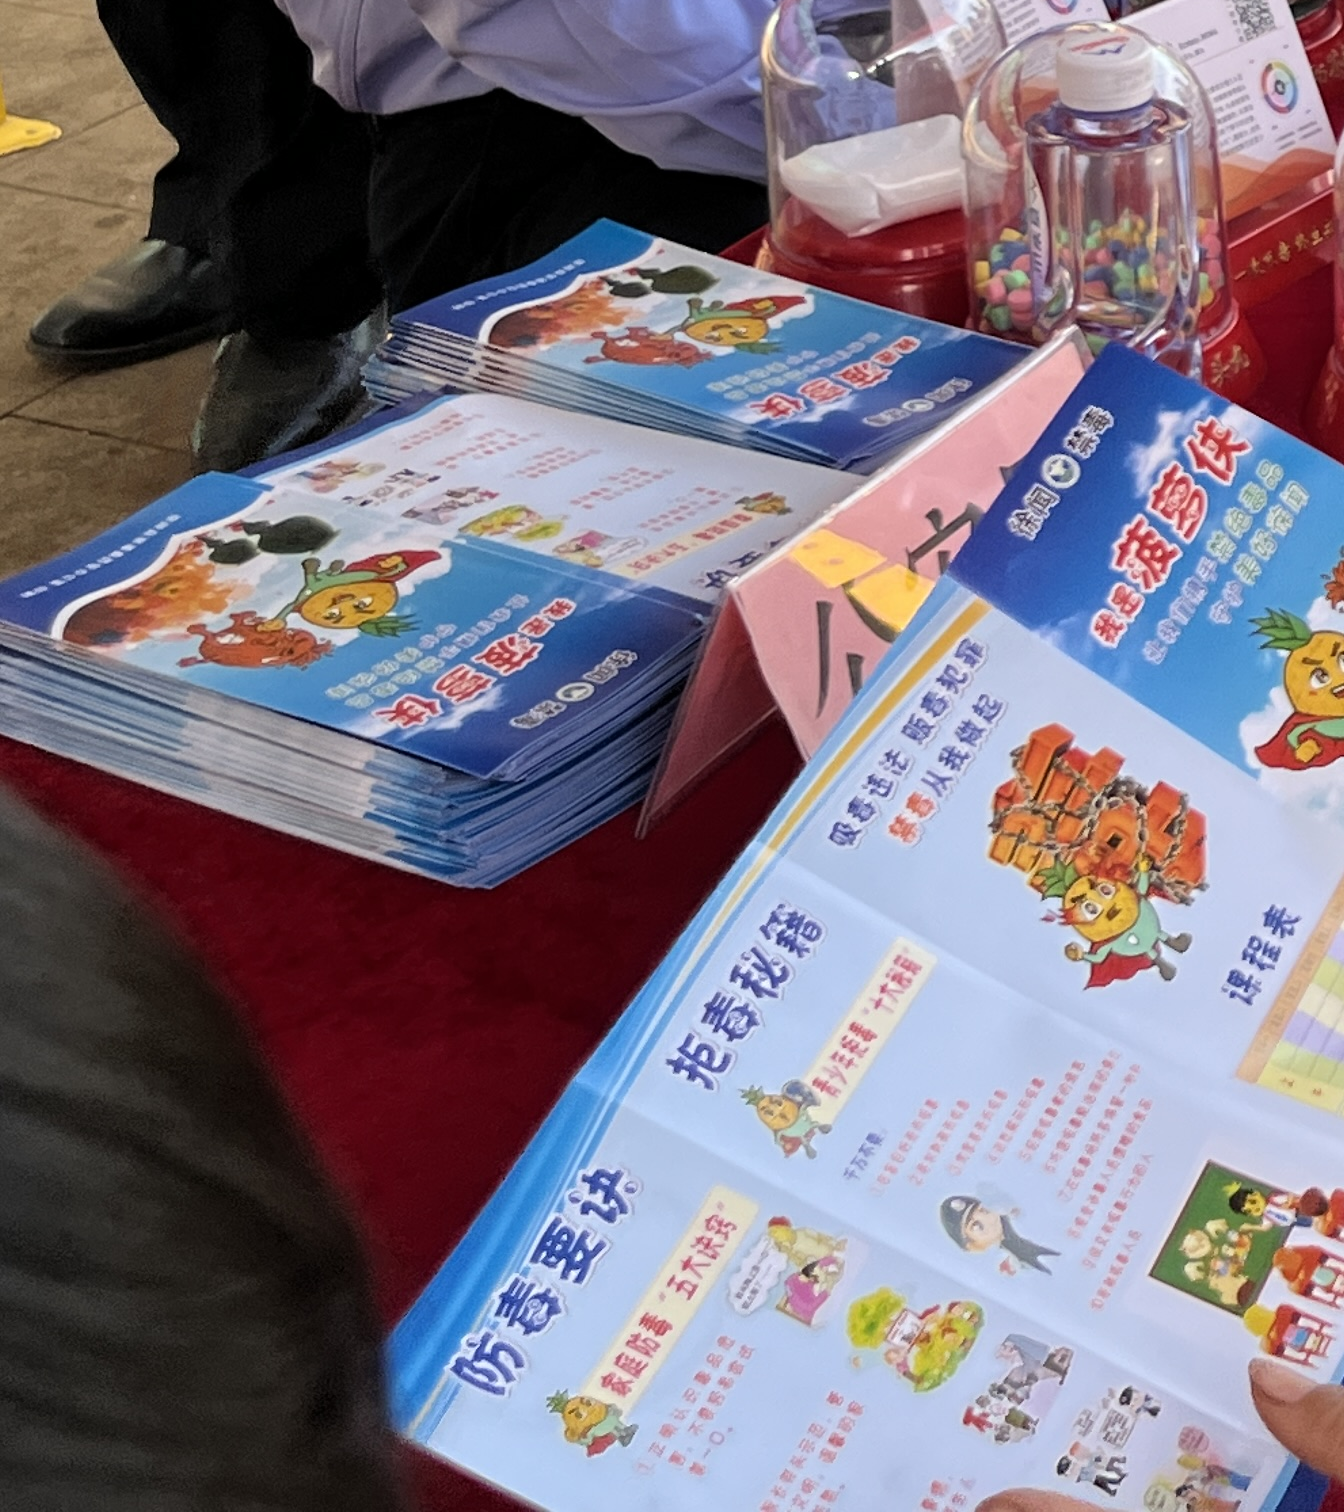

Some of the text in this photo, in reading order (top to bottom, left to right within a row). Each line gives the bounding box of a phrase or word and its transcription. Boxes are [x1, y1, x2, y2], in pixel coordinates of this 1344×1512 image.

[1008, 405, 1115, 540] 徐闻 禁毒
[1091, 417, 1252, 646] 我是菠萝侠
[377, 597, 577, 732] 我是菠萝侠
[827, 634, 987, 851] 吸毒违法 贩毒犯罪
[886, 687, 1003, 846] 禁毒从我做起
[666, 902, 825, 1090] 拒毒秘籍
[1221, 902, 1302, 1006] 课程表
[449, 1168, 637, 1395] 防毒要诀
